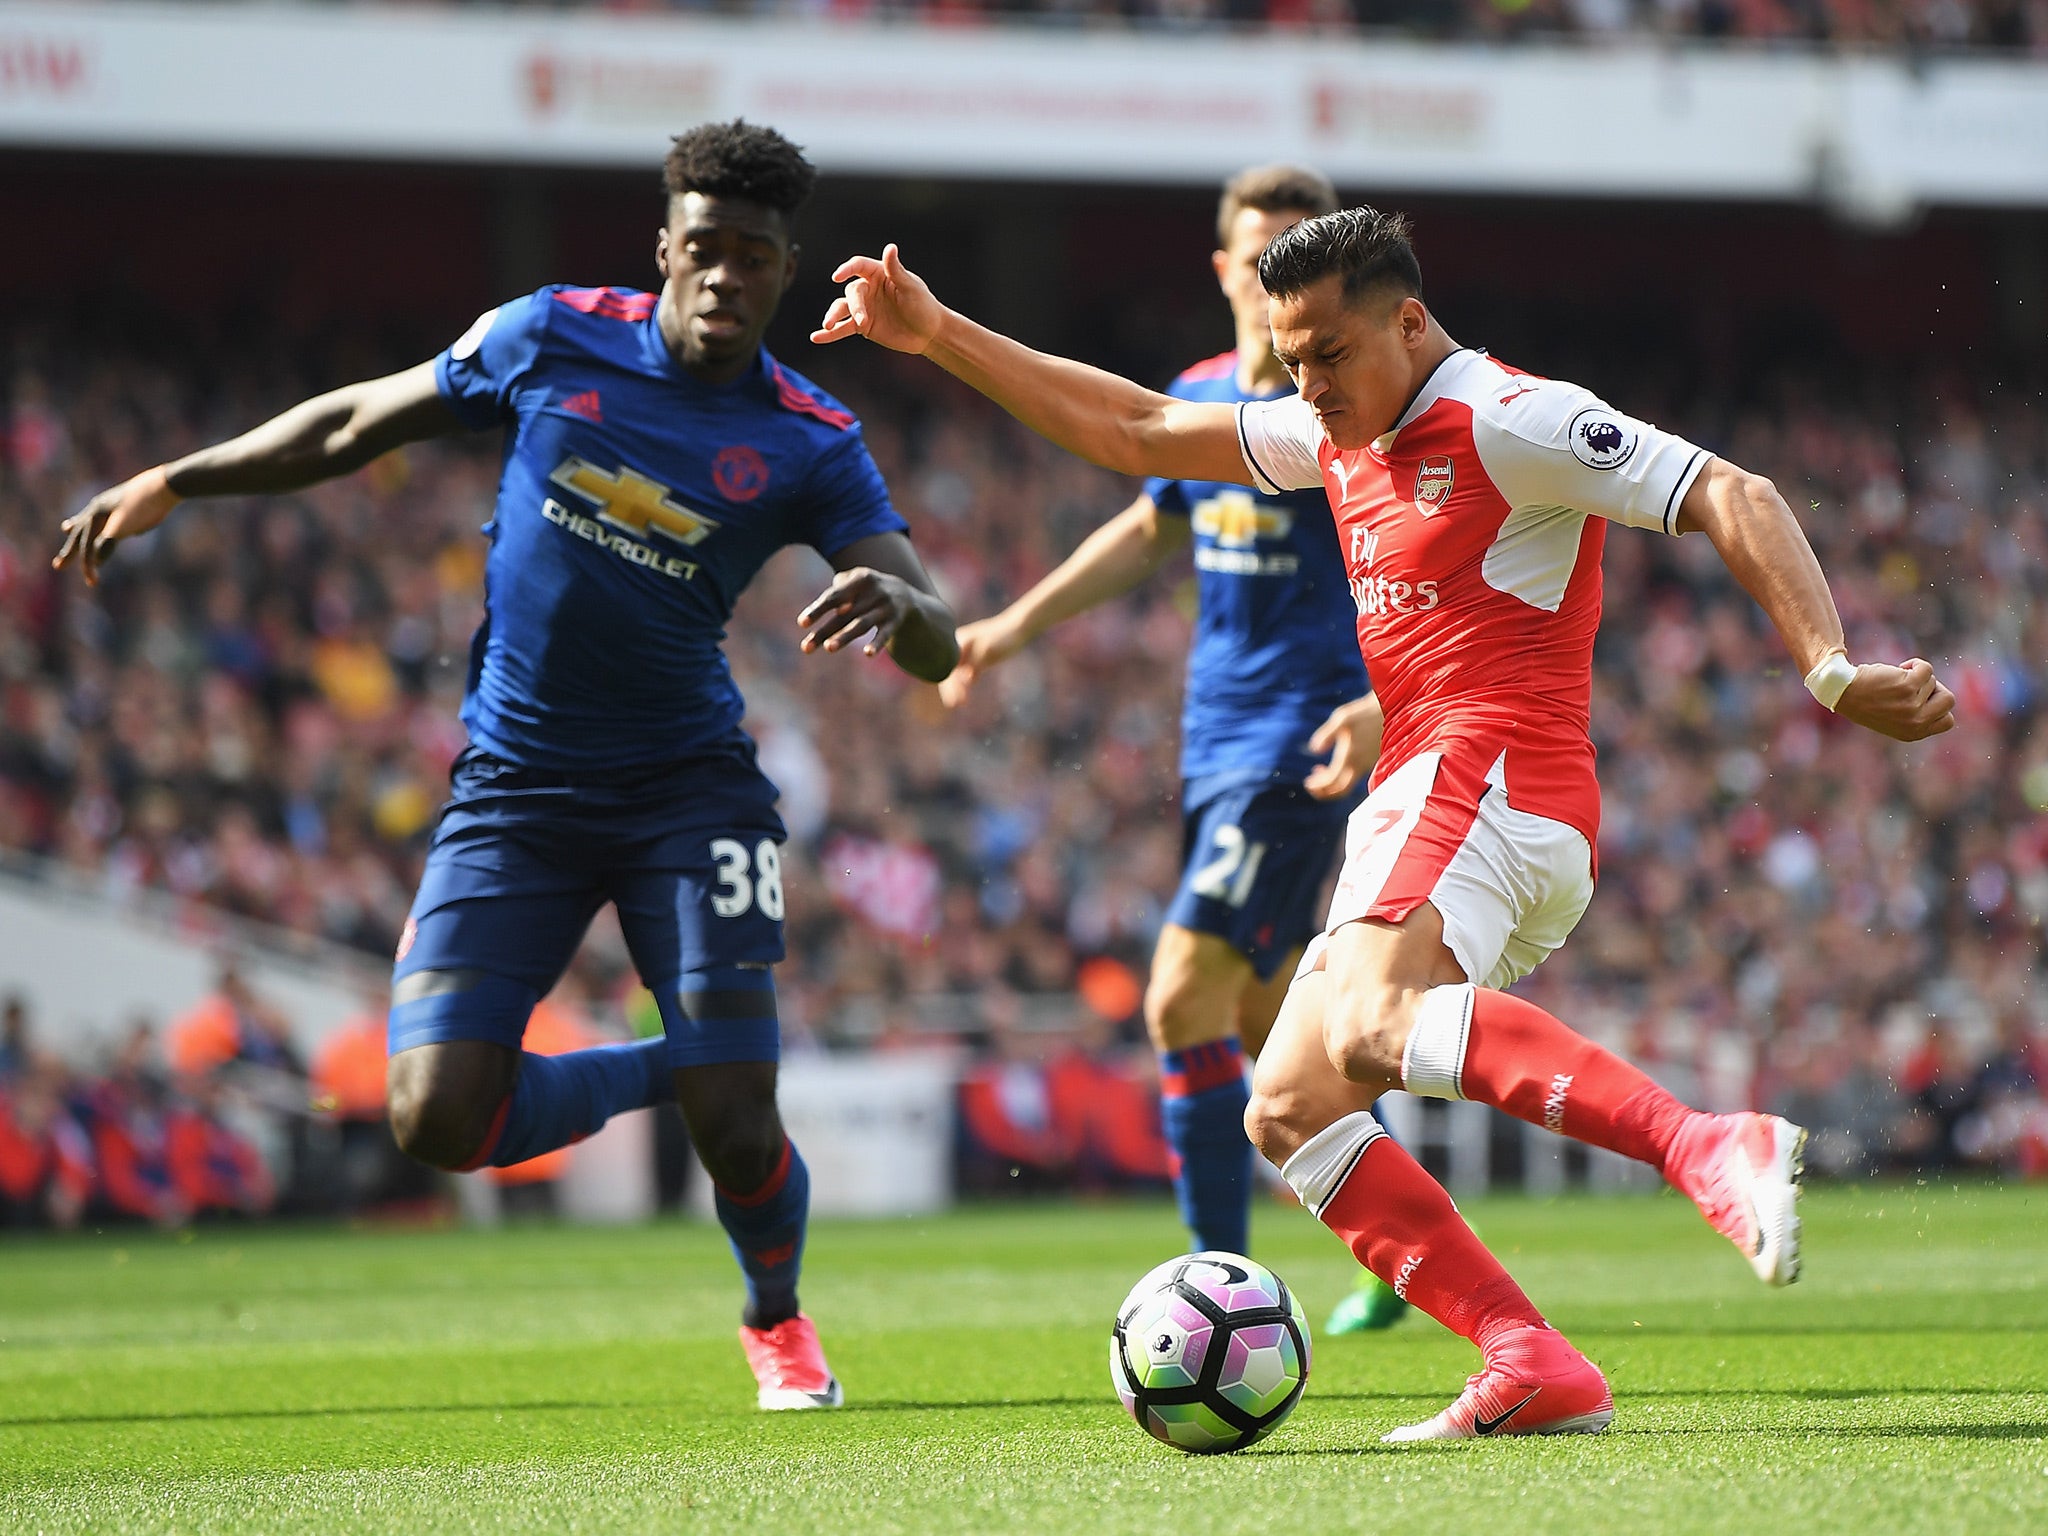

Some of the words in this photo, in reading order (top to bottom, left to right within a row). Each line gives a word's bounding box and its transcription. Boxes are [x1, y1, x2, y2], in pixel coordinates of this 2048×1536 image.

[1421, 465, 1449, 475] Arsenal
[541, 497, 699, 581] CHEVROLET
[1351, 527, 1379, 568] Fly
[709, 837, 785, 921] 38
[1191, 824, 1268, 908] 21
